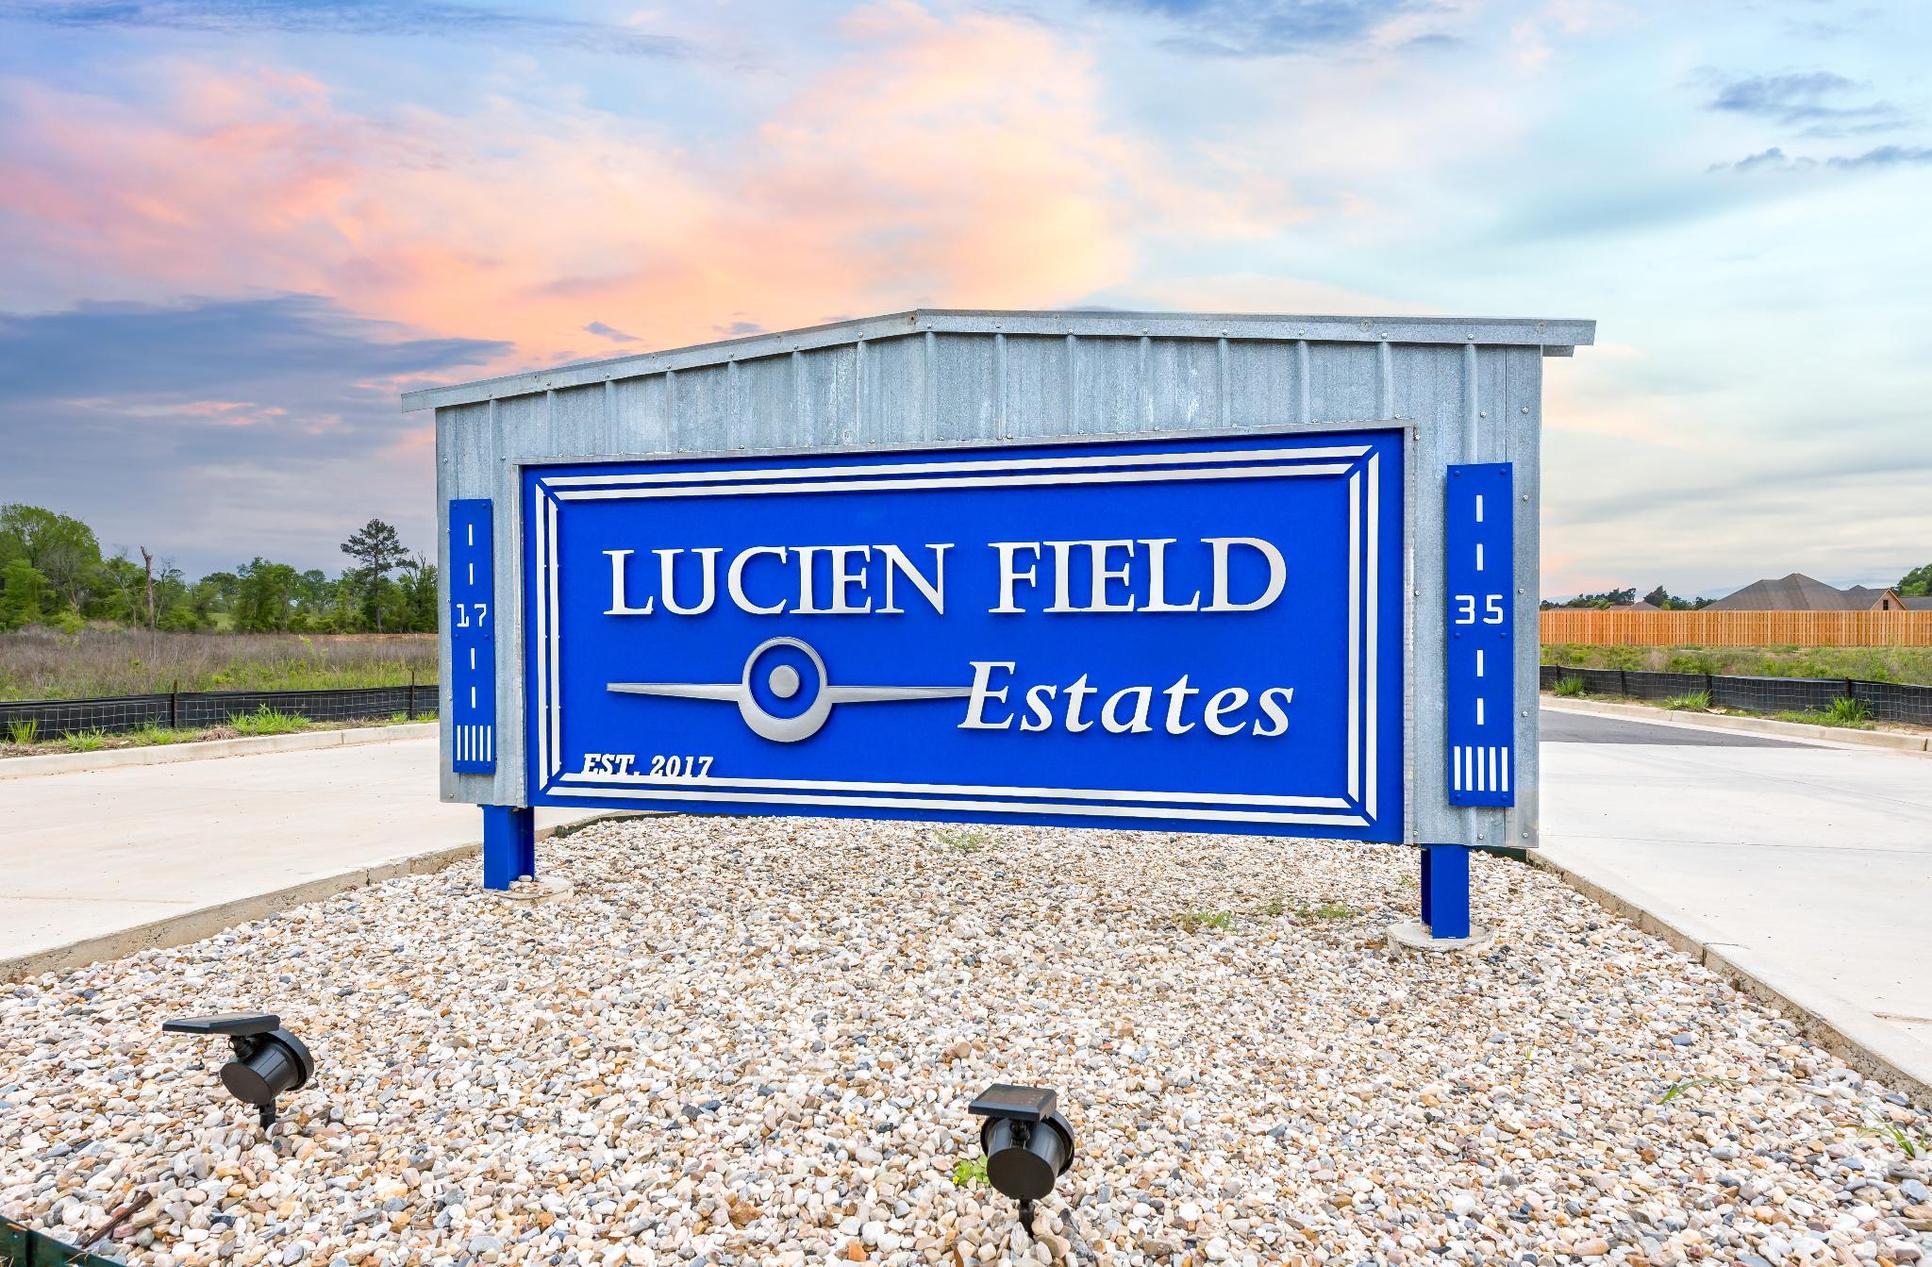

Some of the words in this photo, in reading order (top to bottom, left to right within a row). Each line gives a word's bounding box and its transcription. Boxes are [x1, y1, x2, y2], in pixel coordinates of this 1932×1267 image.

[602, 543, 955, 616] LUCIEN
[987, 536, 1288, 614] FIELD
[456, 603, 488, 628] 17
[1454, 594, 1504, 625] 35
[957, 660, 1295, 738] Estates
[581, 753, 640, 777] EST.
[650, 755, 714, 779] 2017
